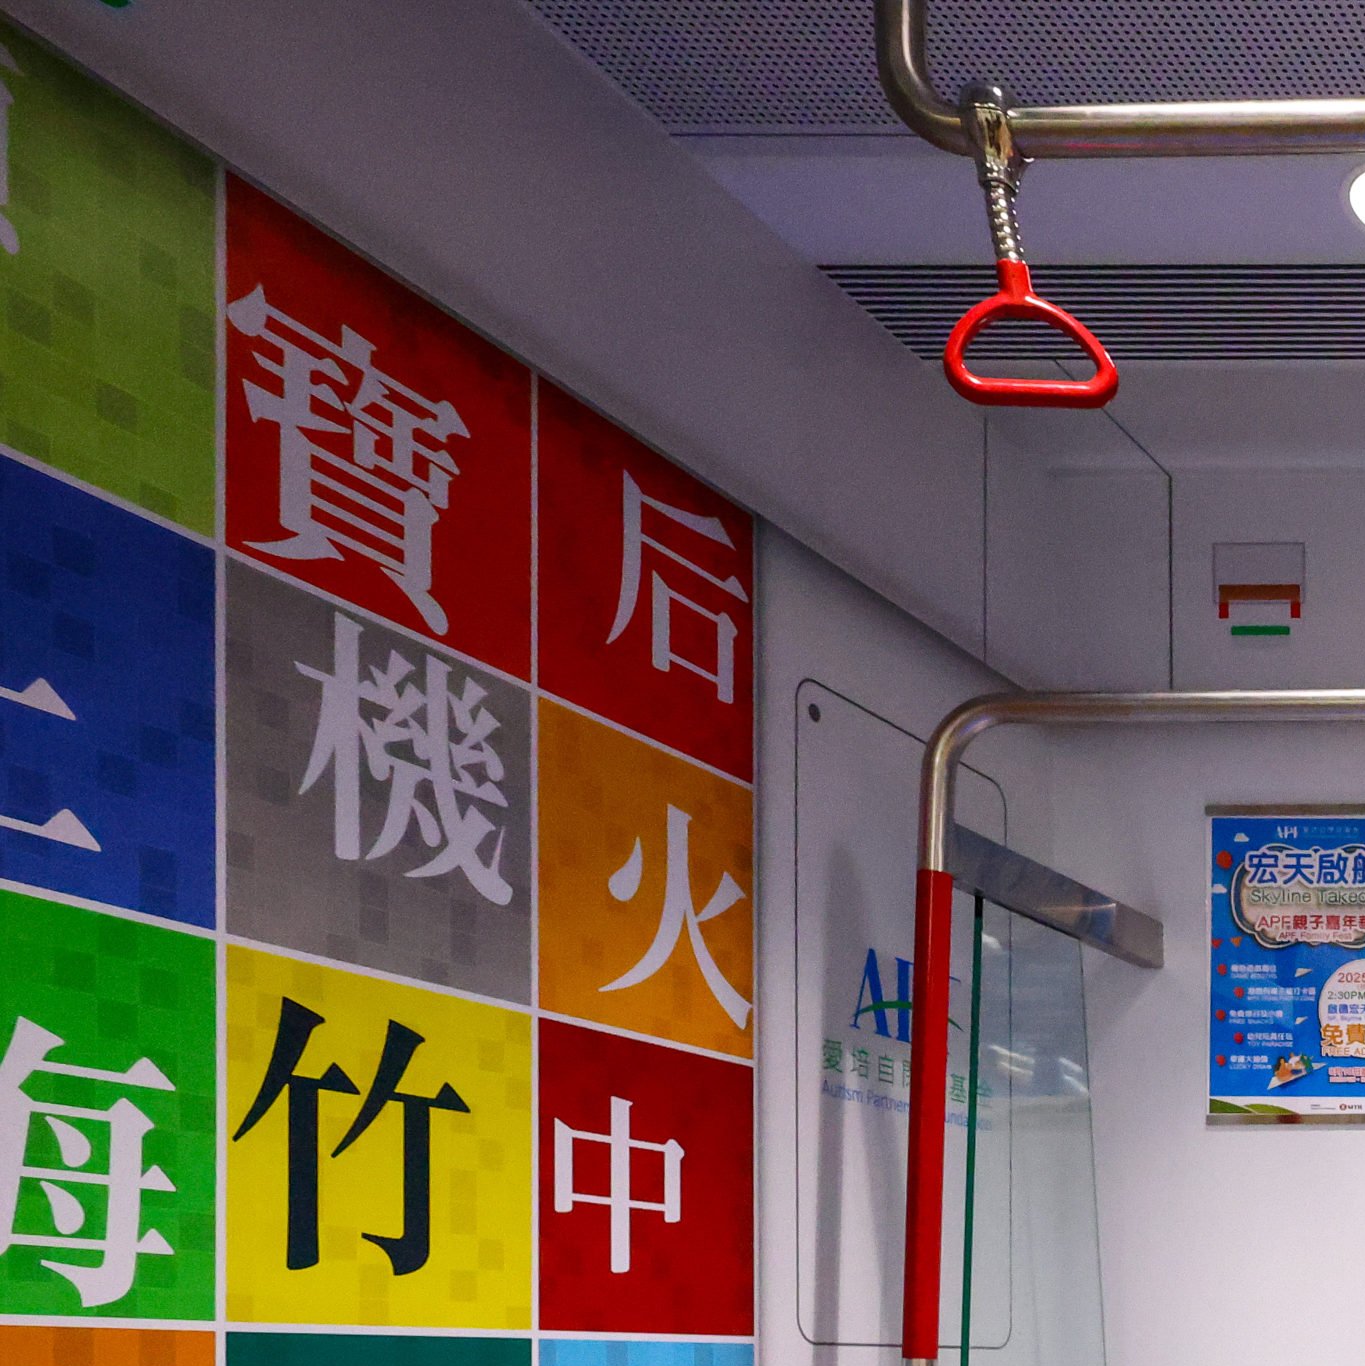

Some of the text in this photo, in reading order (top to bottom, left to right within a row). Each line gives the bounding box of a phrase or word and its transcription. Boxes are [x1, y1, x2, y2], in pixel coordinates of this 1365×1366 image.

[226, 283, 470, 636] 寶
[606, 469, 750, 704] 后
[294, 611, 514, 906] 機
[599, 803, 753, 1030] 火
[1251, 888, 1311, 904] Skyline
[232, 996, 471, 1276] 竹
[1322, 1047, 1351, 1056] FREE
[553, 1095, 685, 1274] 中
